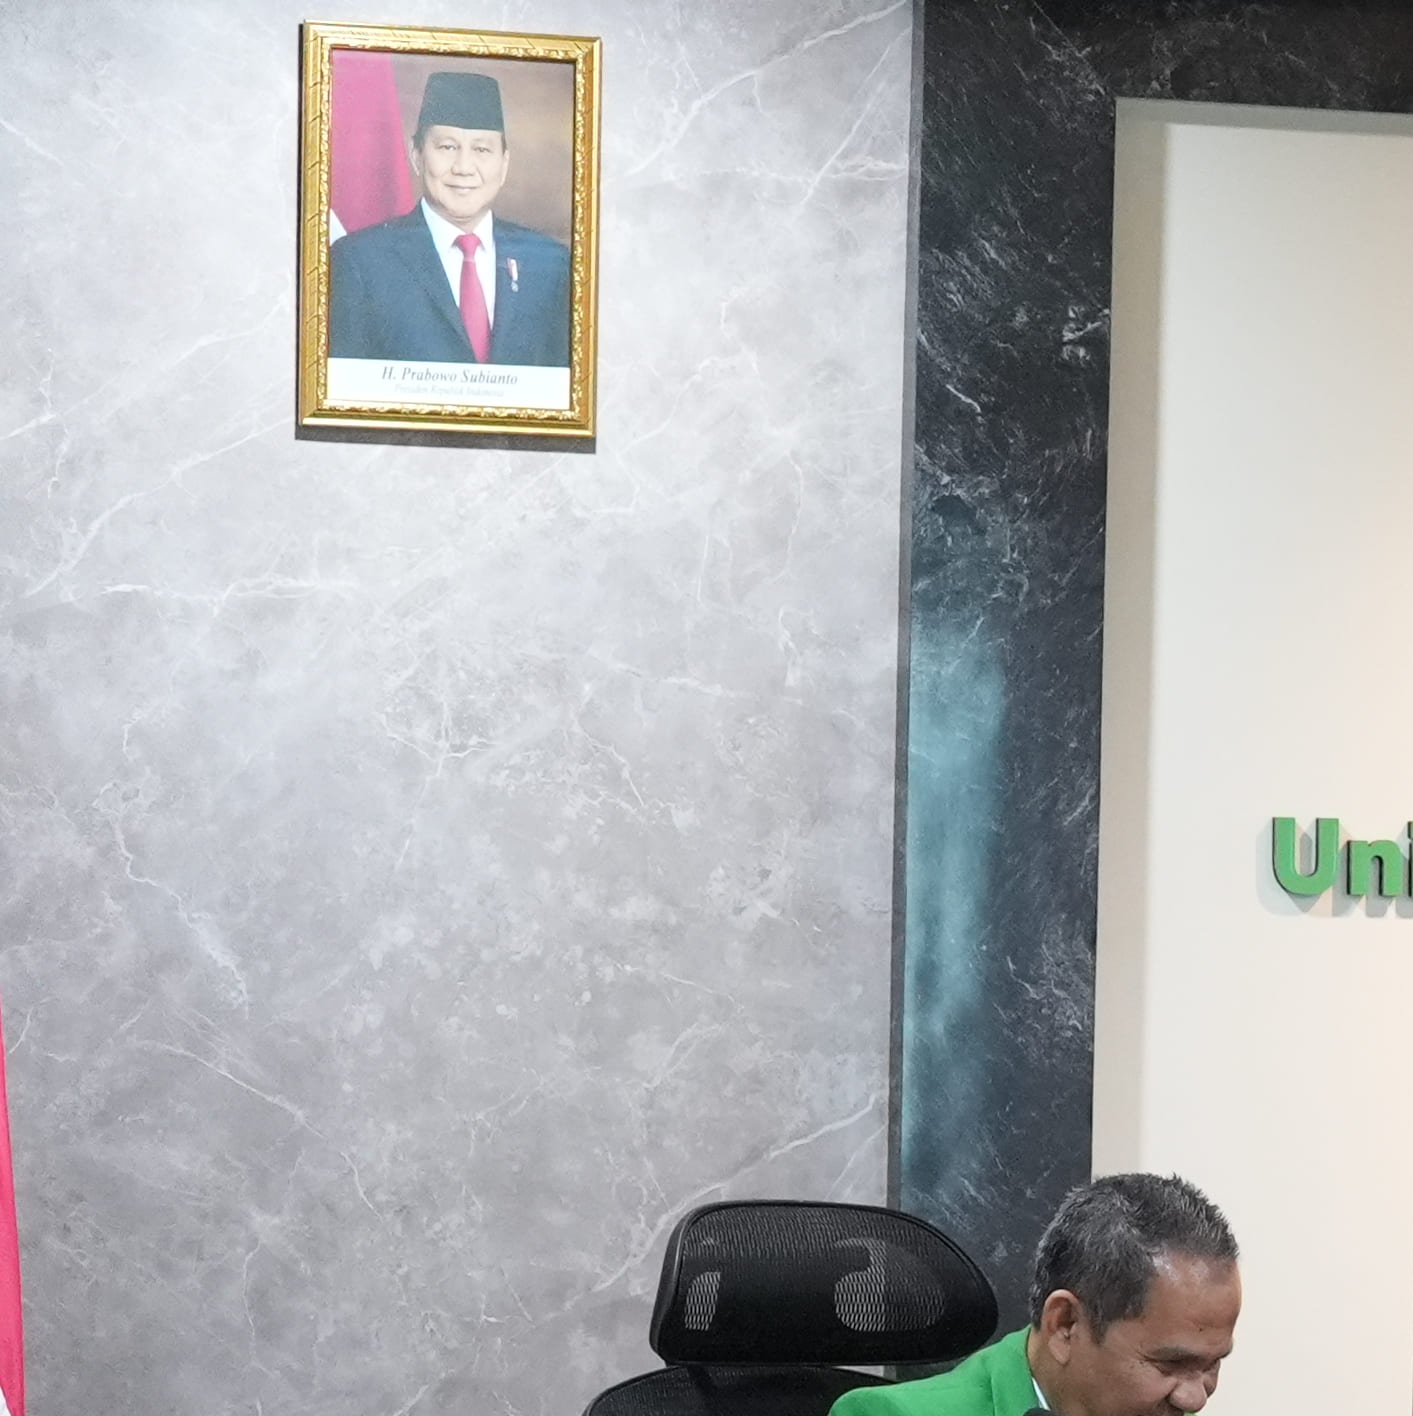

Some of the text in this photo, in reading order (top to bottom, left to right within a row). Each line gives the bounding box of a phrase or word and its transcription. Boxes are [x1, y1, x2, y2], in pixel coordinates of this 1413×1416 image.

[382, 366, 518, 385] H. Prabowo Subianto
